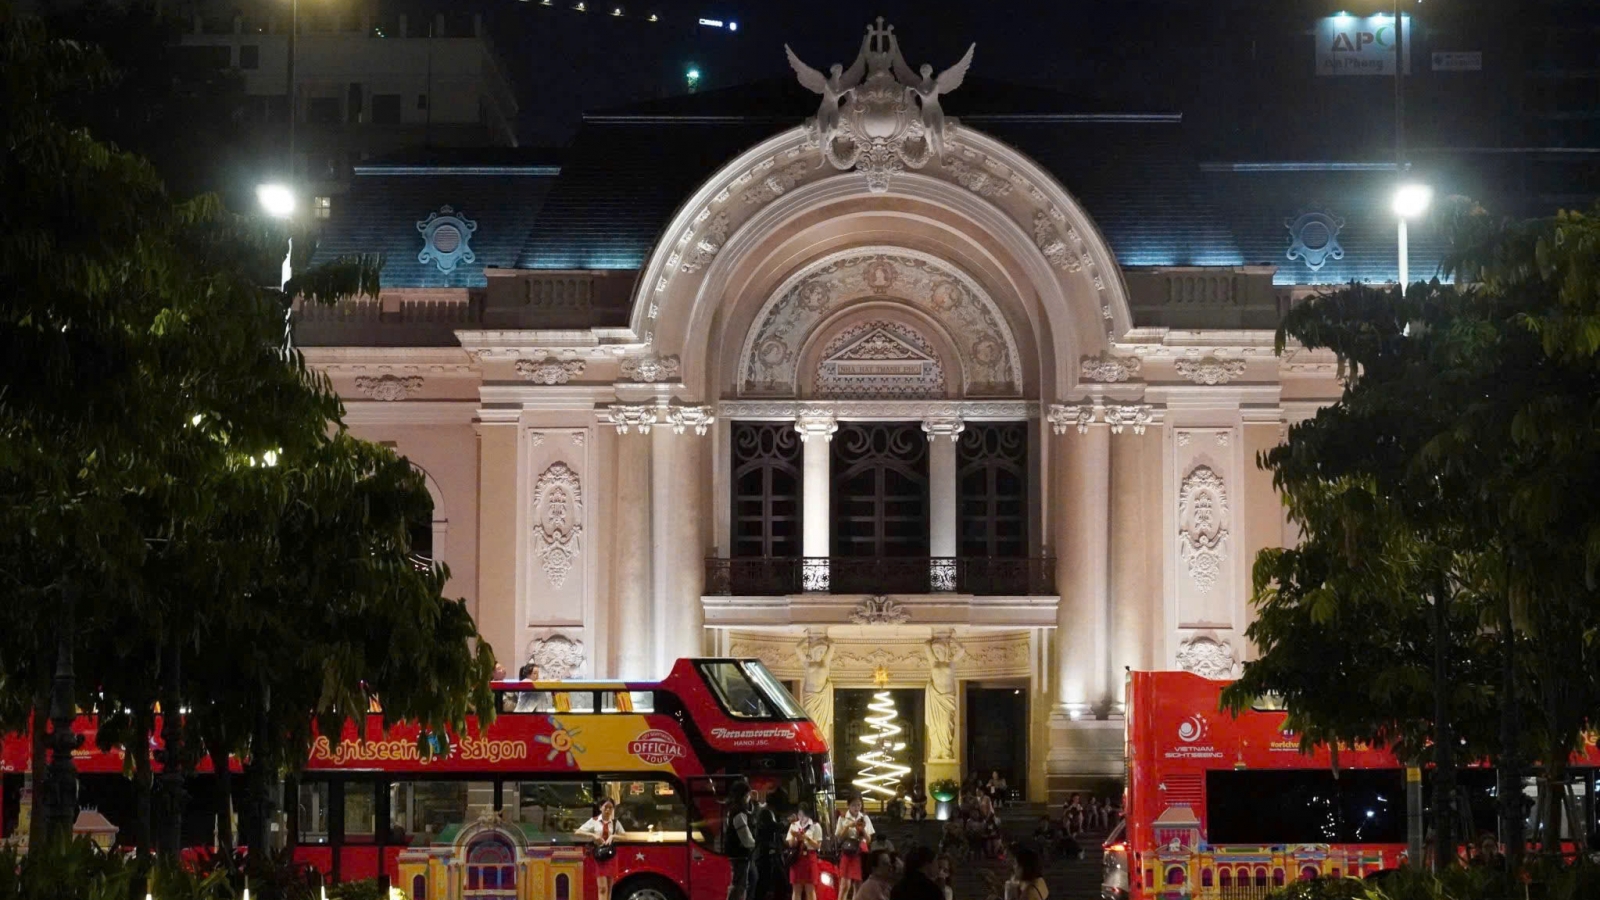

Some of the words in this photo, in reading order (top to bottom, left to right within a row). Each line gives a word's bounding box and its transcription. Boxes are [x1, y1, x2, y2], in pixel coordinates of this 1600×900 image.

[460, 737, 527, 762] Saigon
[633, 742, 682, 756] OFFICIAL
[646, 754, 669, 763] TOUR
